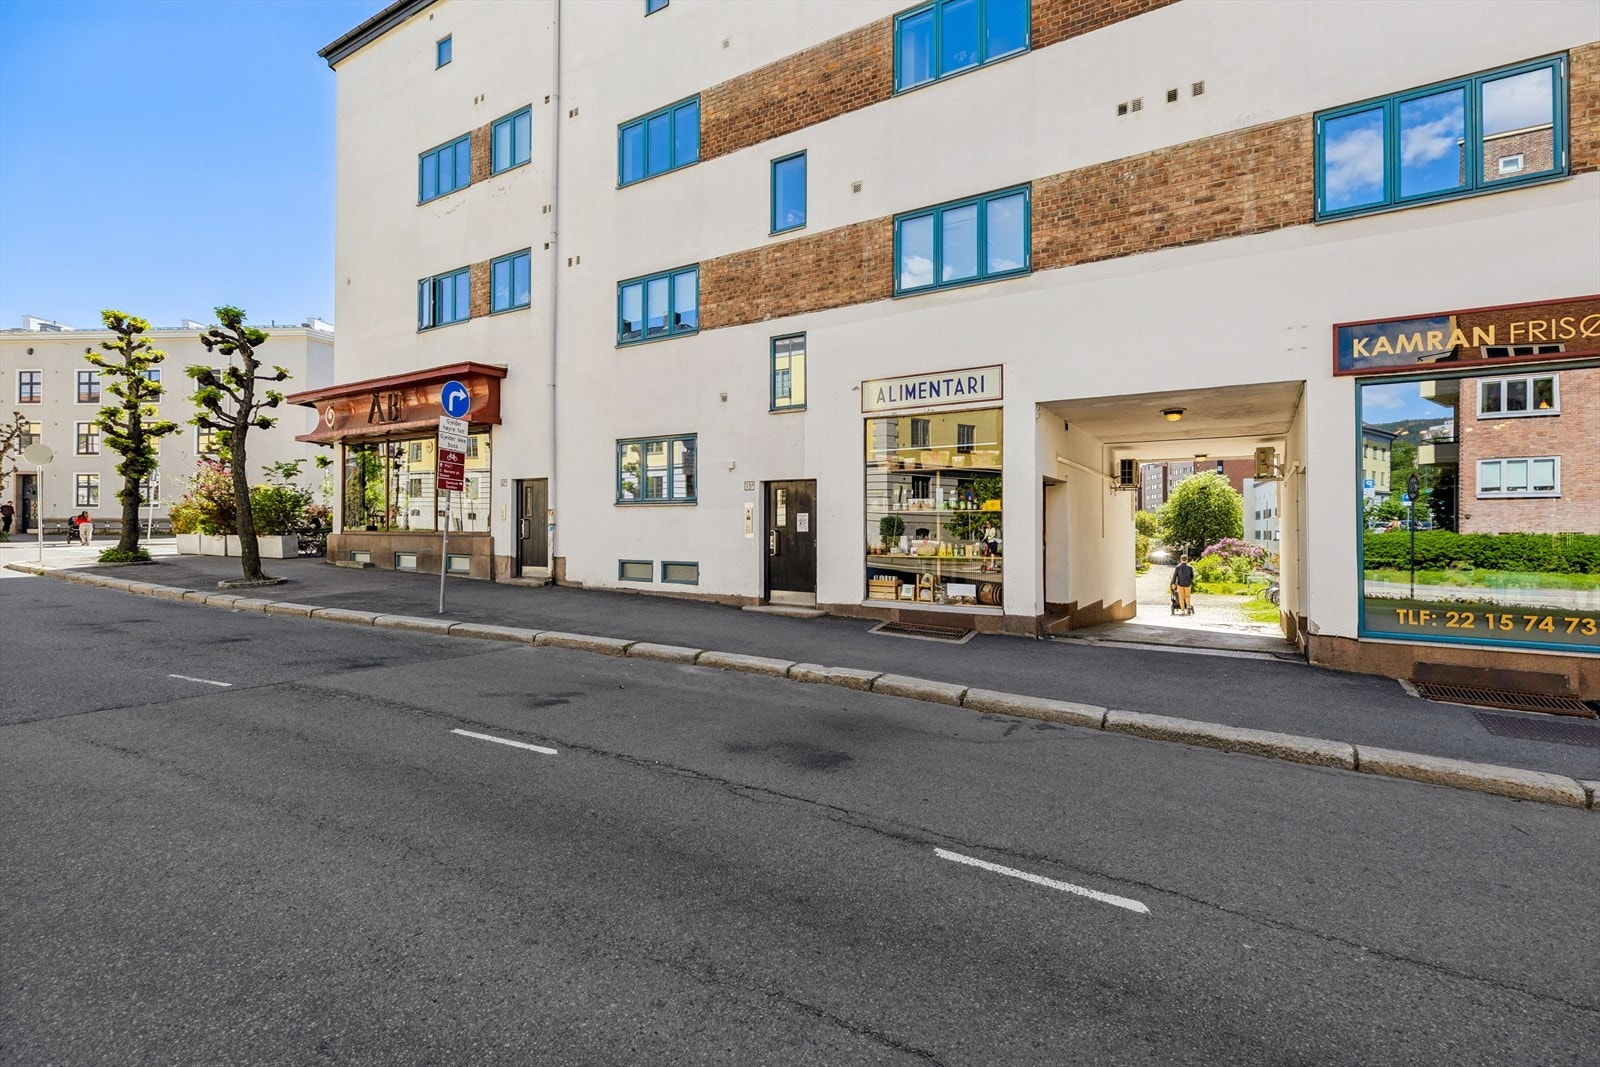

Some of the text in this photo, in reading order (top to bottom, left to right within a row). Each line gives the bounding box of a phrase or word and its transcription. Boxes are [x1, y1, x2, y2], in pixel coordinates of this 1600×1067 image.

[1352, 324, 1495, 358] KAMRAN
[876, 375, 985, 404] ALIMENTARI
[1396, 608, 1597, 636] TLF: 22 15 74 73
